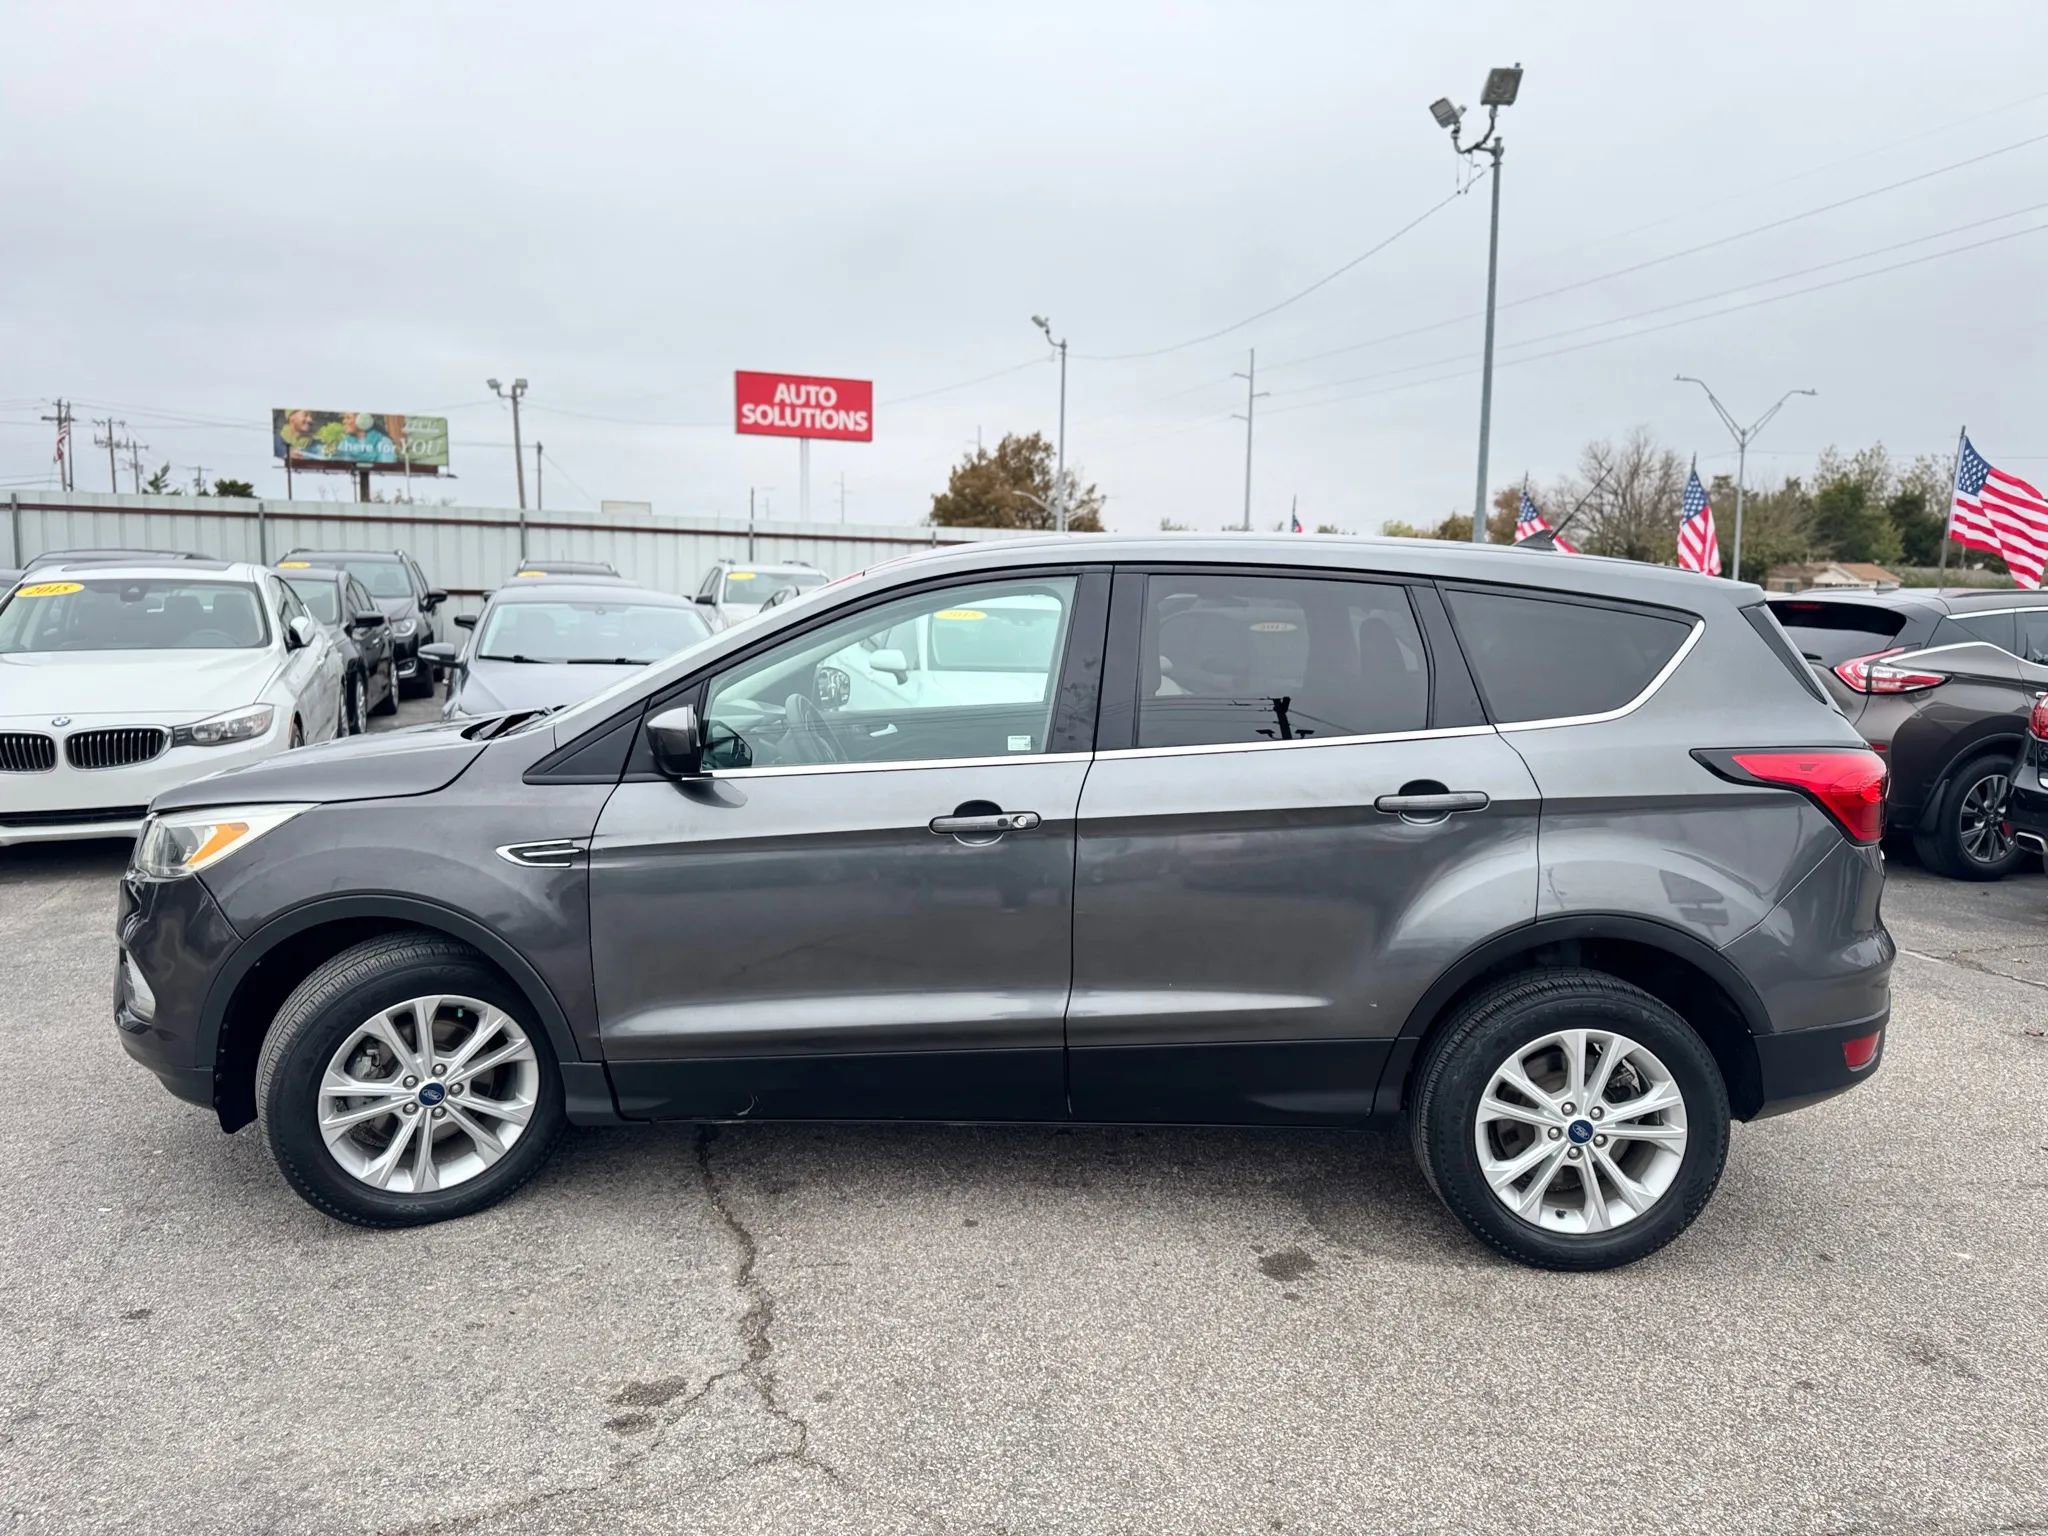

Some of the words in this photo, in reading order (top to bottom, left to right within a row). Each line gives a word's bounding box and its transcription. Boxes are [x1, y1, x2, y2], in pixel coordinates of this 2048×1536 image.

[774, 383, 837, 407] AUTO
[741, 403, 869, 432] SOLUTIONS
[400, 437, 442, 456] YOU
